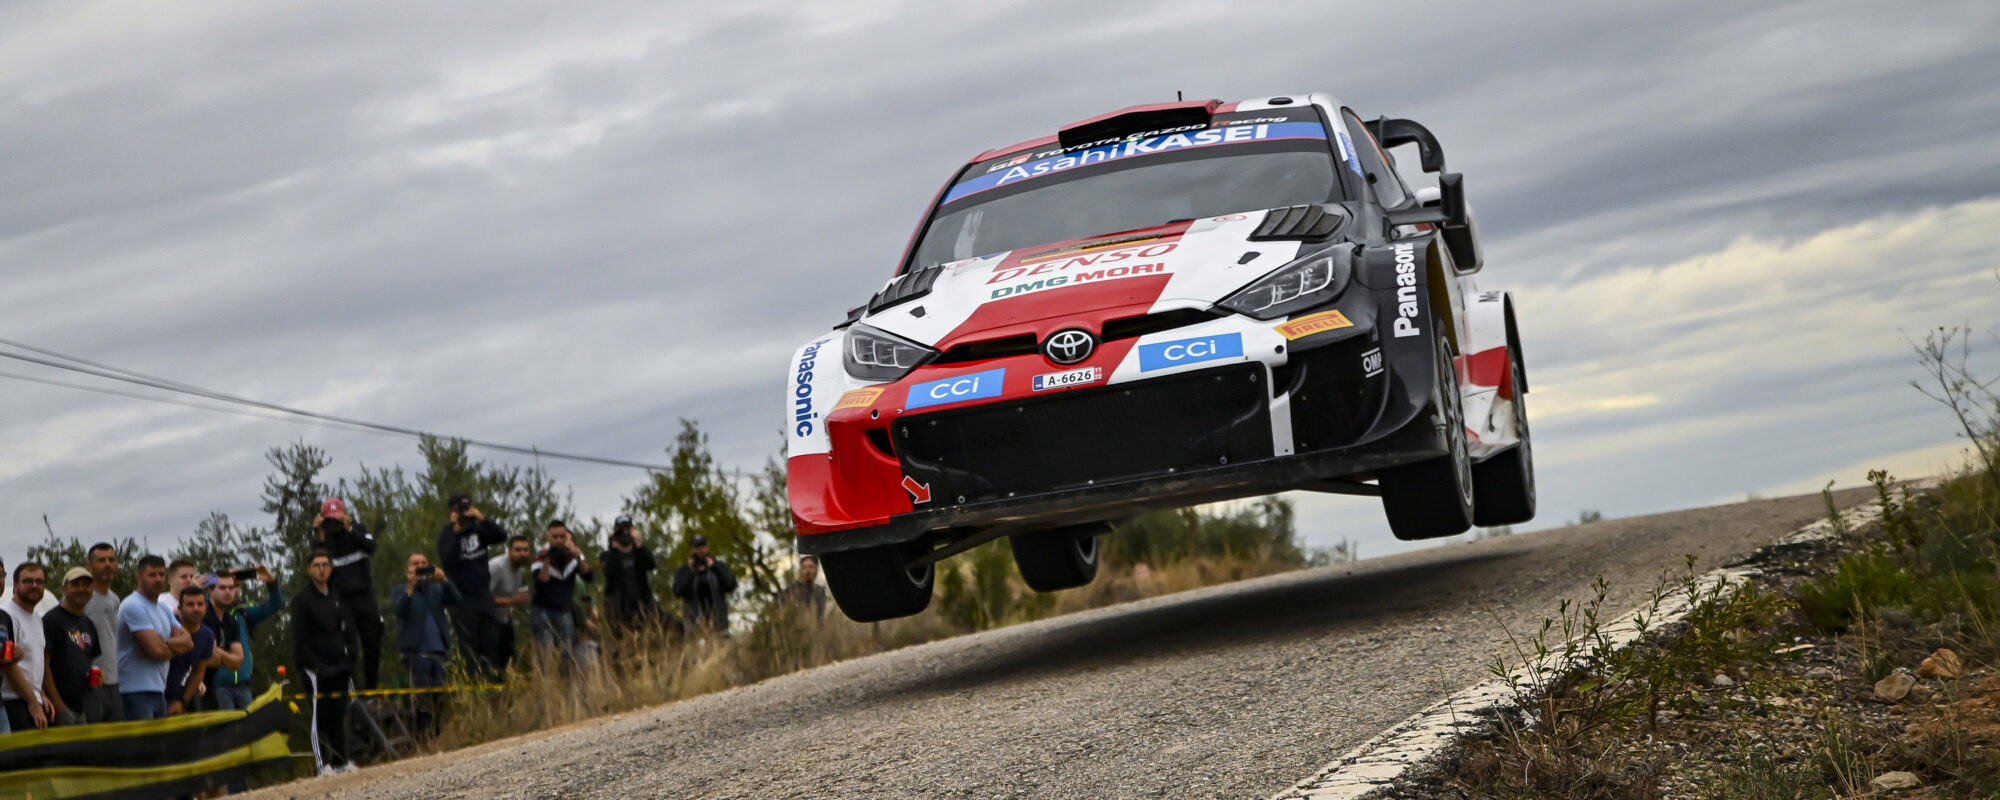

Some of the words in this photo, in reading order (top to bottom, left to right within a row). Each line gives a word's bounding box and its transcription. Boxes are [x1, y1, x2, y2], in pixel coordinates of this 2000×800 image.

[1035, 137, 1120, 158] TOYOTA
[1126, 123, 1207, 140] GAZOO
[1212, 116, 1288, 128] Racing
[986, 243, 1178, 285] DENSO
[990, 275, 1069, 299] DMG
[1073, 262, 1165, 282] MORI
[1281, 313, 1346, 336] PIRELLI
[1048, 370, 1091, 386] A-6626
[1362, 351, 1382, 373] OMP
[795, 338, 832, 437] Panasonic
